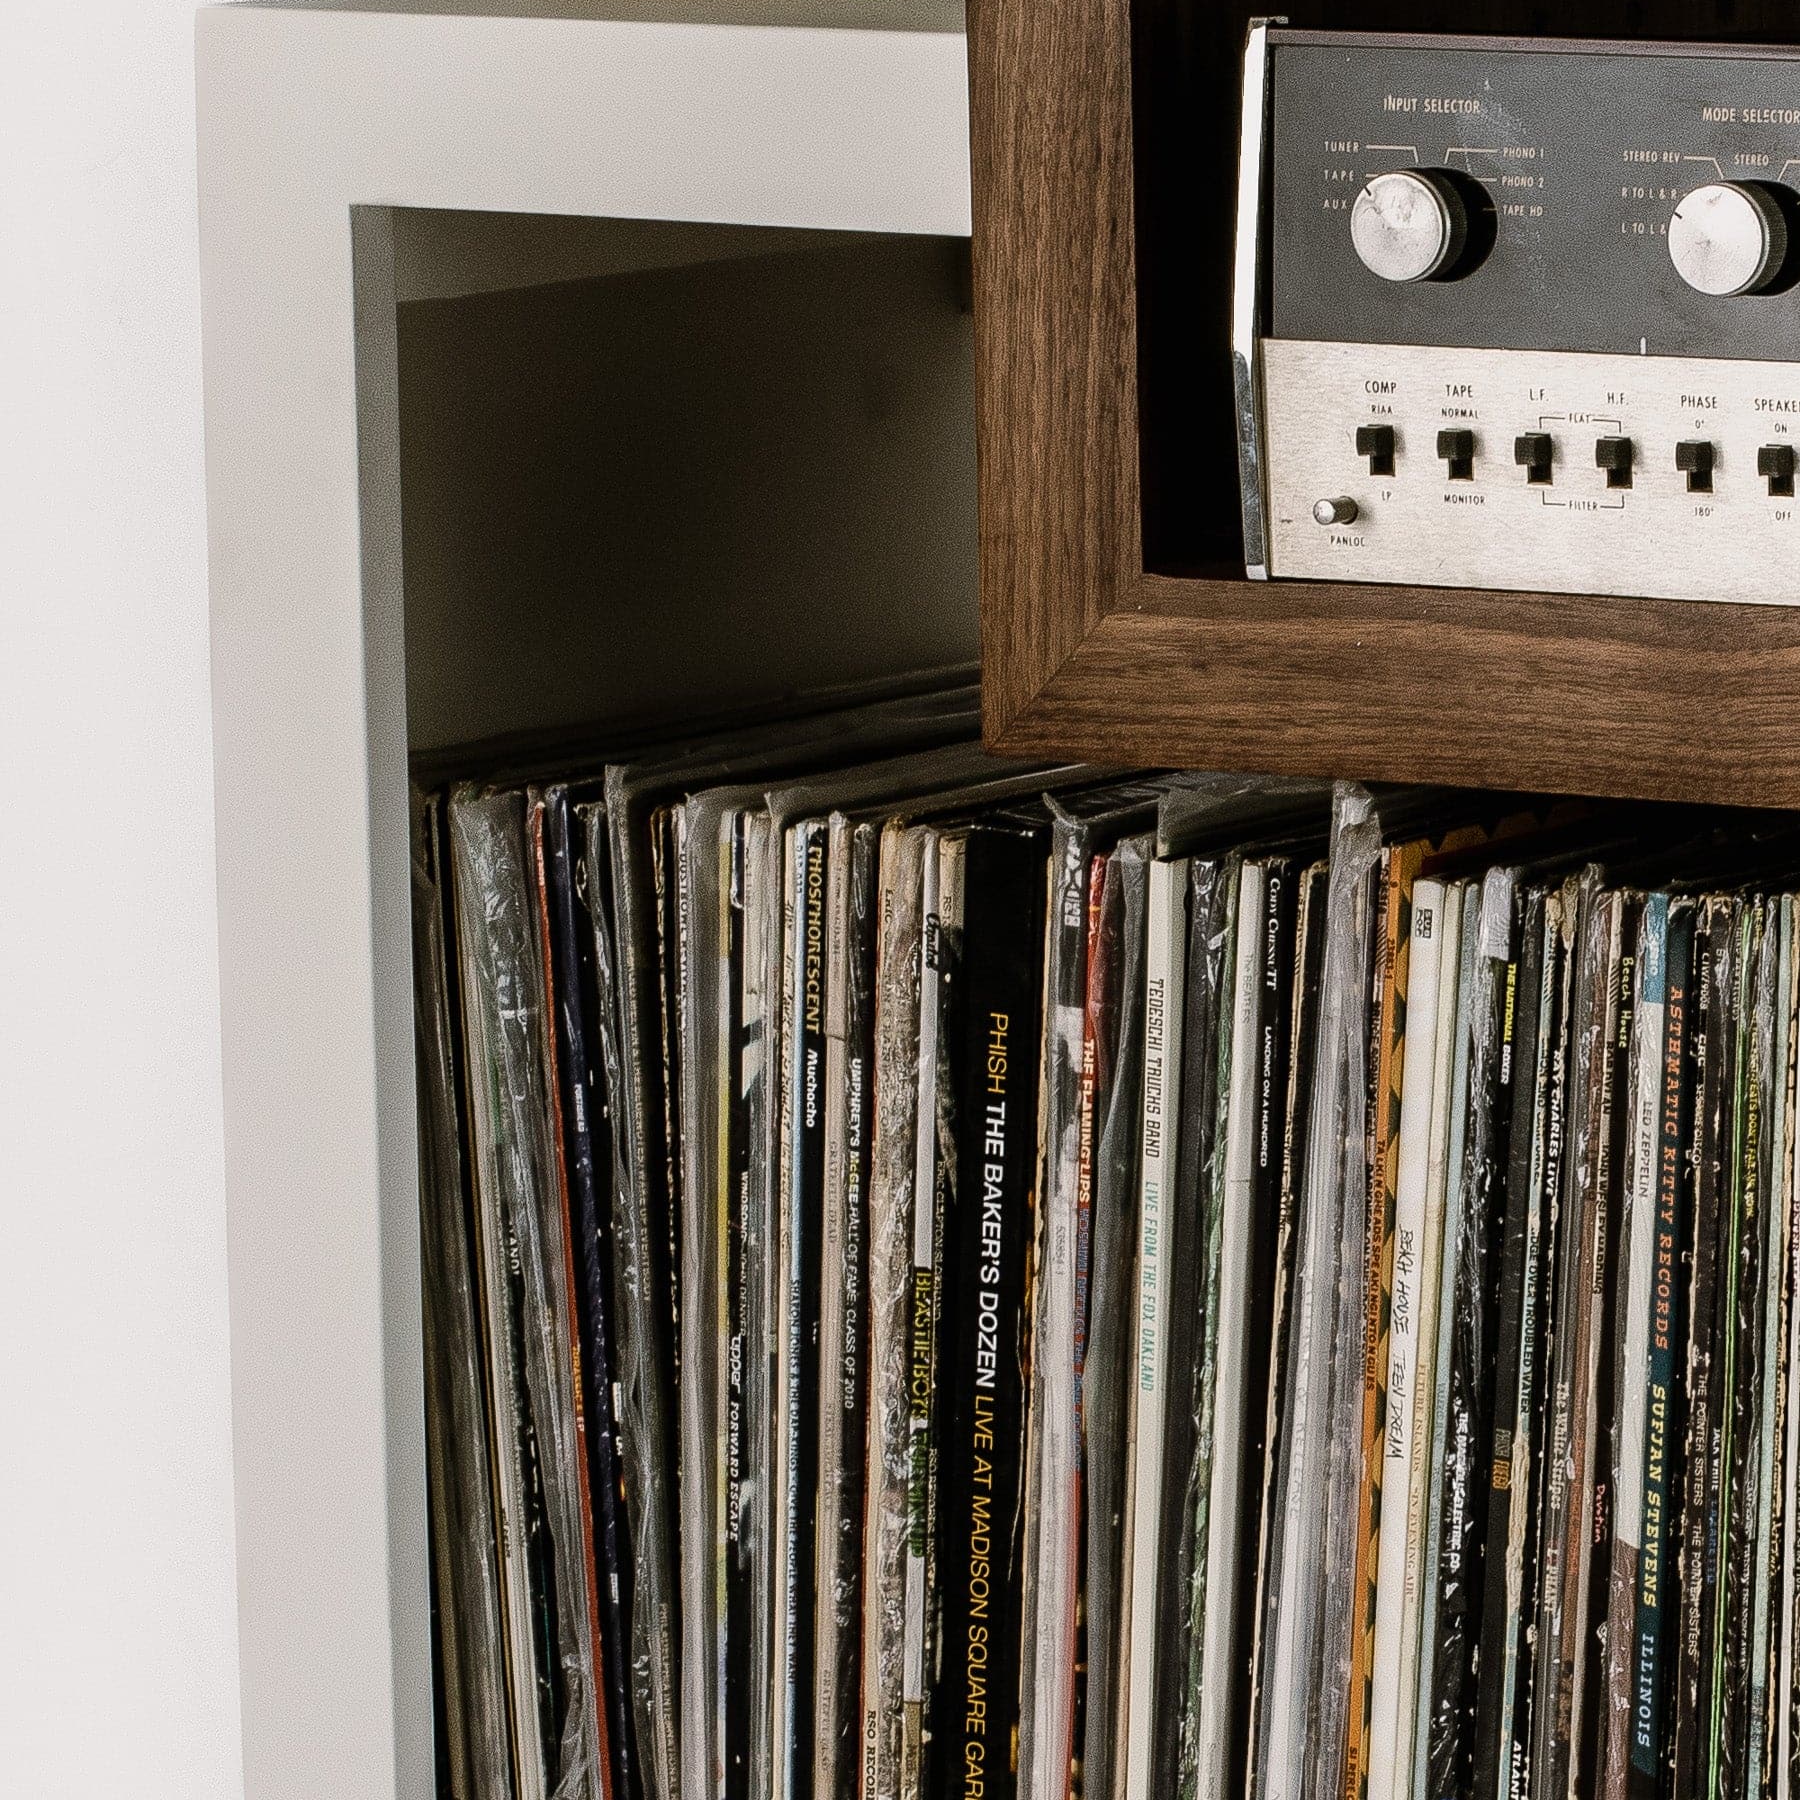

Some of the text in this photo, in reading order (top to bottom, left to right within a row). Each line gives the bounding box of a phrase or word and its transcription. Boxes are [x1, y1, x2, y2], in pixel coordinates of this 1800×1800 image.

[1384, 97, 1481, 113] INPUT SELECTOR
[1703, 108, 1800, 123] MODE SELECTOR
[1324, 141, 1360, 152] TUNER
[1503, 147, 1535, 158] PHONO
[1624, 150, 1680, 163] STEREO REV
[1734, 153, 1769, 166] STEREO
[1324, 170, 1354, 181] TAPE
[1502, 176, 1544, 188] PHONO 2
[1323, 199, 1347, 209] AUX
[1503, 205, 1542, 216] TAPE HD
[1365, 380, 1397, 395] COMP
[1445, 384, 1473, 398] TAPE
[1529, 389, 1548, 401] L.F.
[1607, 392, 1628, 405] H.F.
[1681, 395, 1718, 409] PHASE
[1371, 404, 1392, 414] RIAA
[1441, 408, 1478, 419] NORMAL
[1569, 413, 1590, 424] FLAT
[1774, 424, 1787, 433] ON
[1382, 491, 1392, 501] LP
[1444, 494, 1485, 505] MONITOR
[1569, 500, 1597, 511] FILTER
[1776, 511, 1791, 520] OFF
[1330, 535, 1365, 547] PANLOC
[804, 846, 823, 1127] PHOSPHORESCENT Muchacho
[988, 1013, 1009, 1093] PHISH
[1262, 1026, 1273, 1075] LANDING
[1261, 1080, 1271, 1096] ON
[984, 1102, 1005, 1155] THE
[1546, 1050, 1561, 1195] RAY CHARLES LIVE
[1259, 1111, 1270, 1167] HUNDRED
[1638, 1101, 1653, 1197] LED ZEPPELIN
[1140, 978, 1164, 1391] TEDESCHI TRUCKS BAND LIVE FROM THE FOX OAKLAND
[980, 1164, 1003, 1283] BAKER'S
[975, 1293, 998, 1387] DOZEN
[1386, 1227, 1415, 1459] BEACH HOUSE TEEN DREAM
[1638, 986, 1684, 1747] ASTHMATIC KITTY RECORDS SUFJAN STEVENS ILLINOIS
[974, 1395, 994, 1448] LIVE
[973, 1456, 992, 1489] AT
[969, 1496, 991, 1617] MADISON
[965, 1626, 987, 1733] SQUARE
